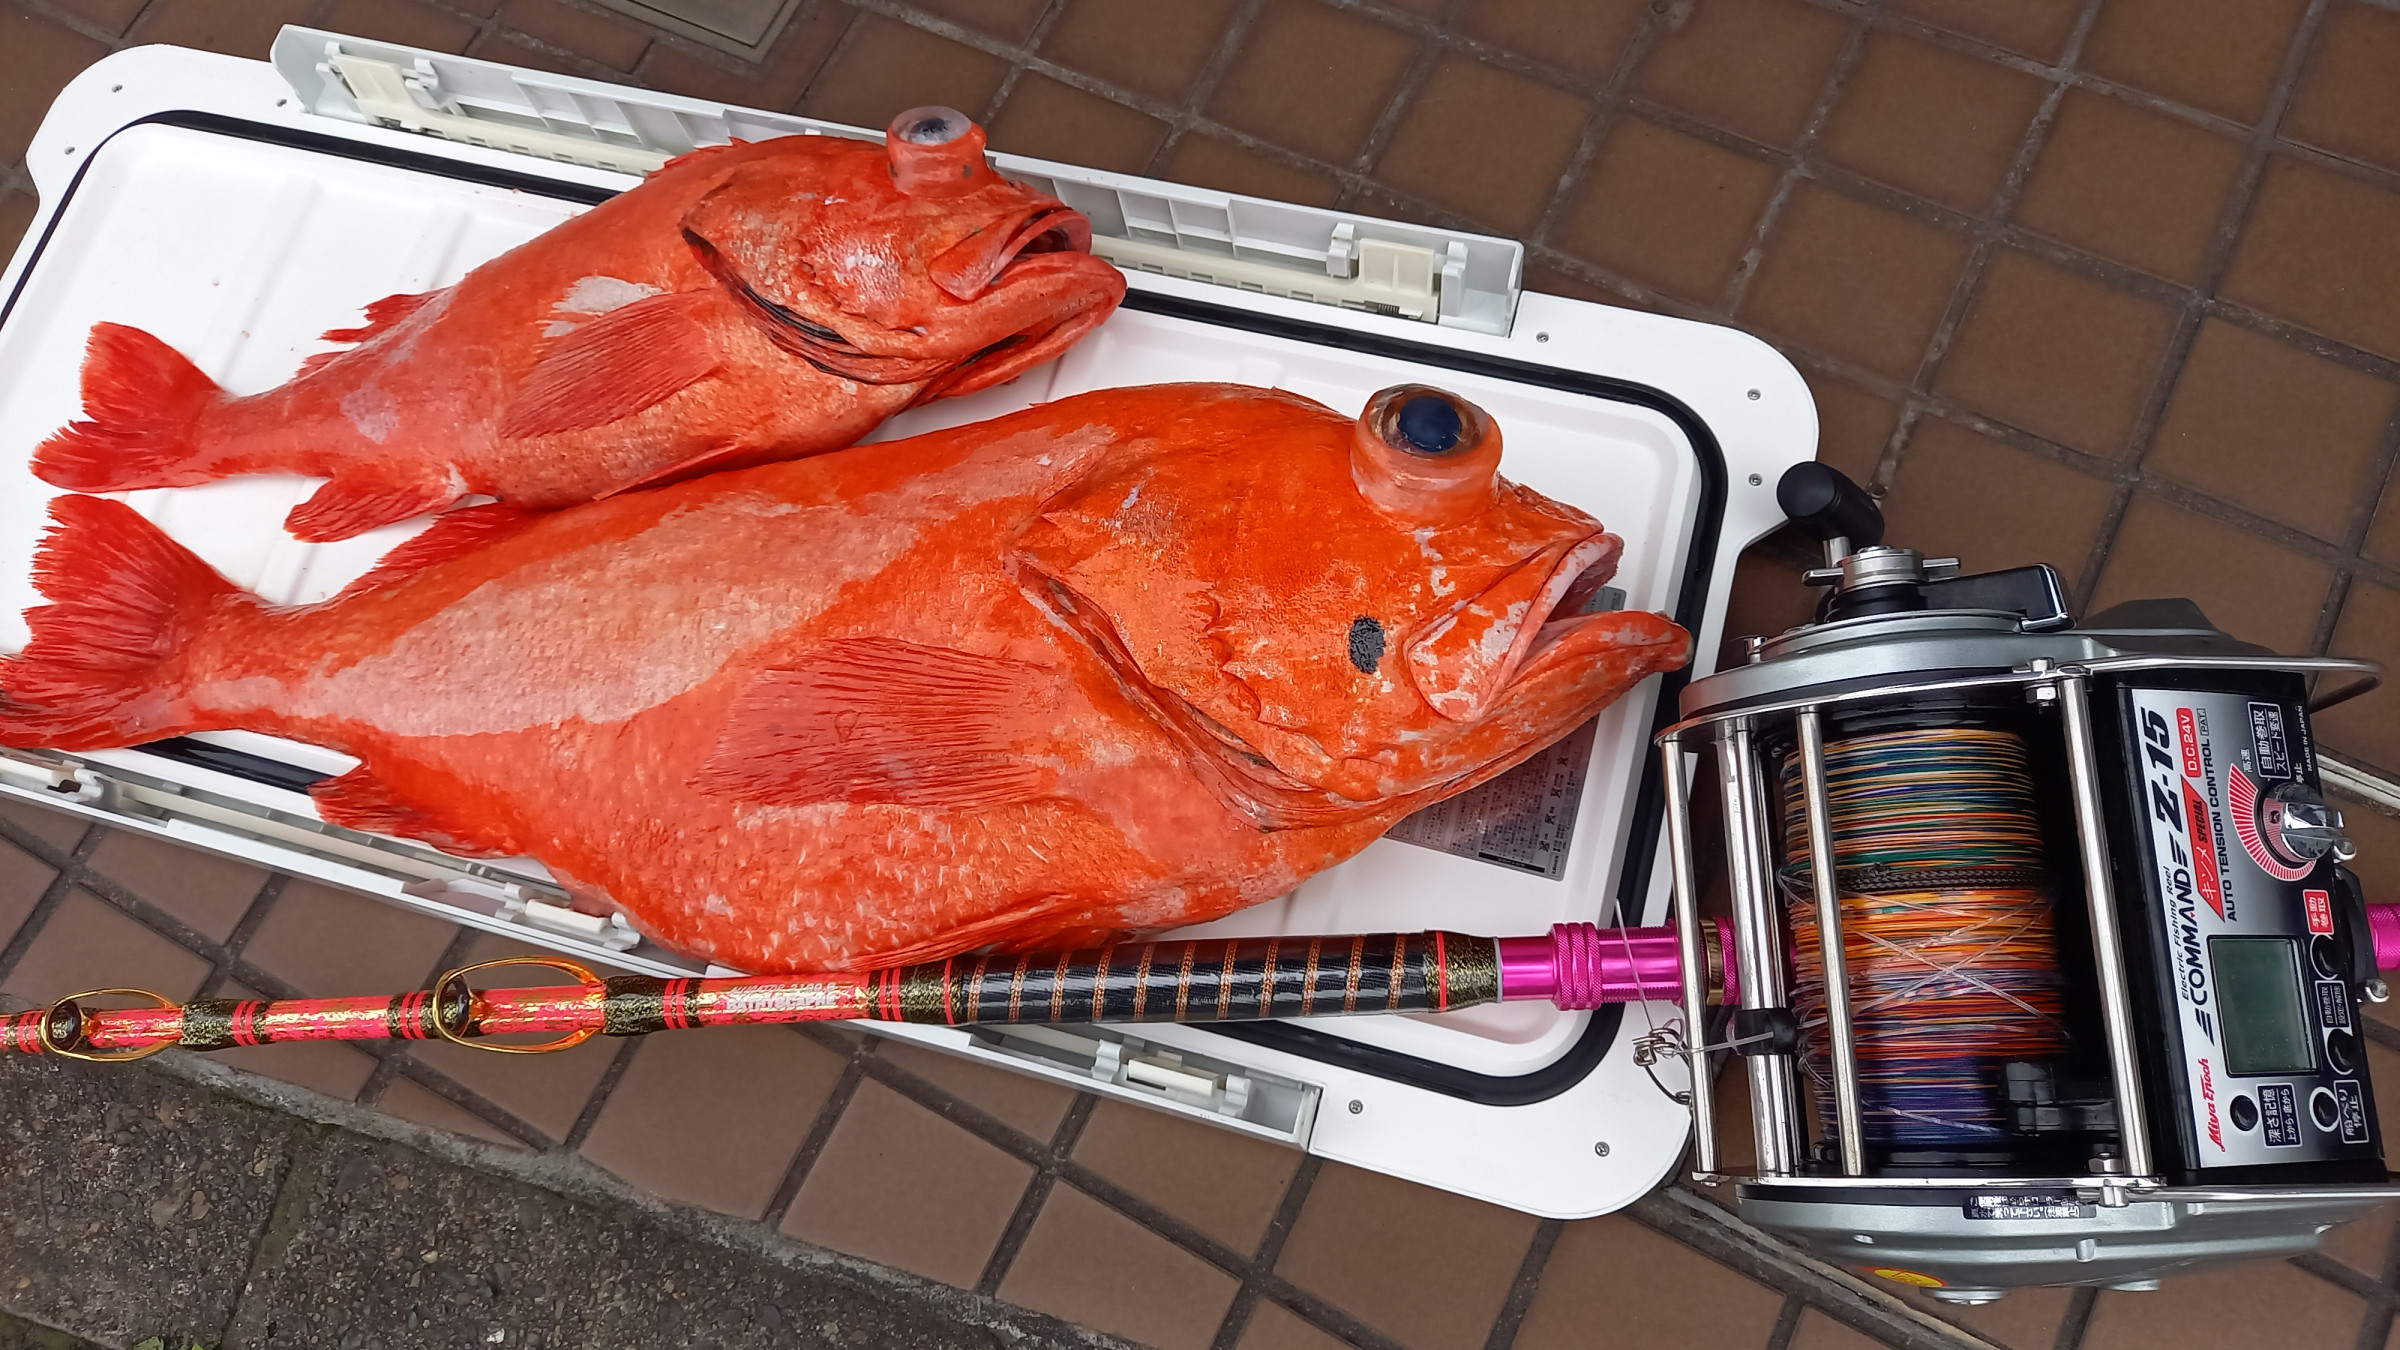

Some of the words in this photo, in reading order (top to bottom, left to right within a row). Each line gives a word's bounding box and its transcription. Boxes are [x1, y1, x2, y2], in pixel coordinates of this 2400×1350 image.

[2180, 714, 2198, 771] D.C.24V
[2253, 710, 2273, 769] 自動巻取
[2268, 711, 2287, 772] スピード変速
[2297, 705, 2307, 735] JAPAN
[2302, 736, 2309, 745] IN
[2140, 706, 2183, 834] Z-15
[2201, 738, 2219, 808] CONTROL
[2240, 748, 2253, 773] 高速
[2303, 747, 2312, 772] MADE
[2192, 800, 2208, 844] SPECIAL
[2211, 811, 2230, 876] TENSION
[2162, 865, 2174, 895] Reel
[2196, 845, 2217, 900] キンメ
[2169, 898, 2182, 948] Fishing
[2222, 879, 2237, 922] AUTO
[2309, 896, 2321, 929] 手動
[2173, 868, 2208, 1006] COMMAND
[2176, 951, 2190, 1001] Electric
[2207, 1101, 2226, 1153] Miya
[2262, 1088, 2282, 1143] 深さ記憶
[2280, 1088, 2298, 1143] 上から・底から
[2350, 1094, 2363, 1128] 停止
